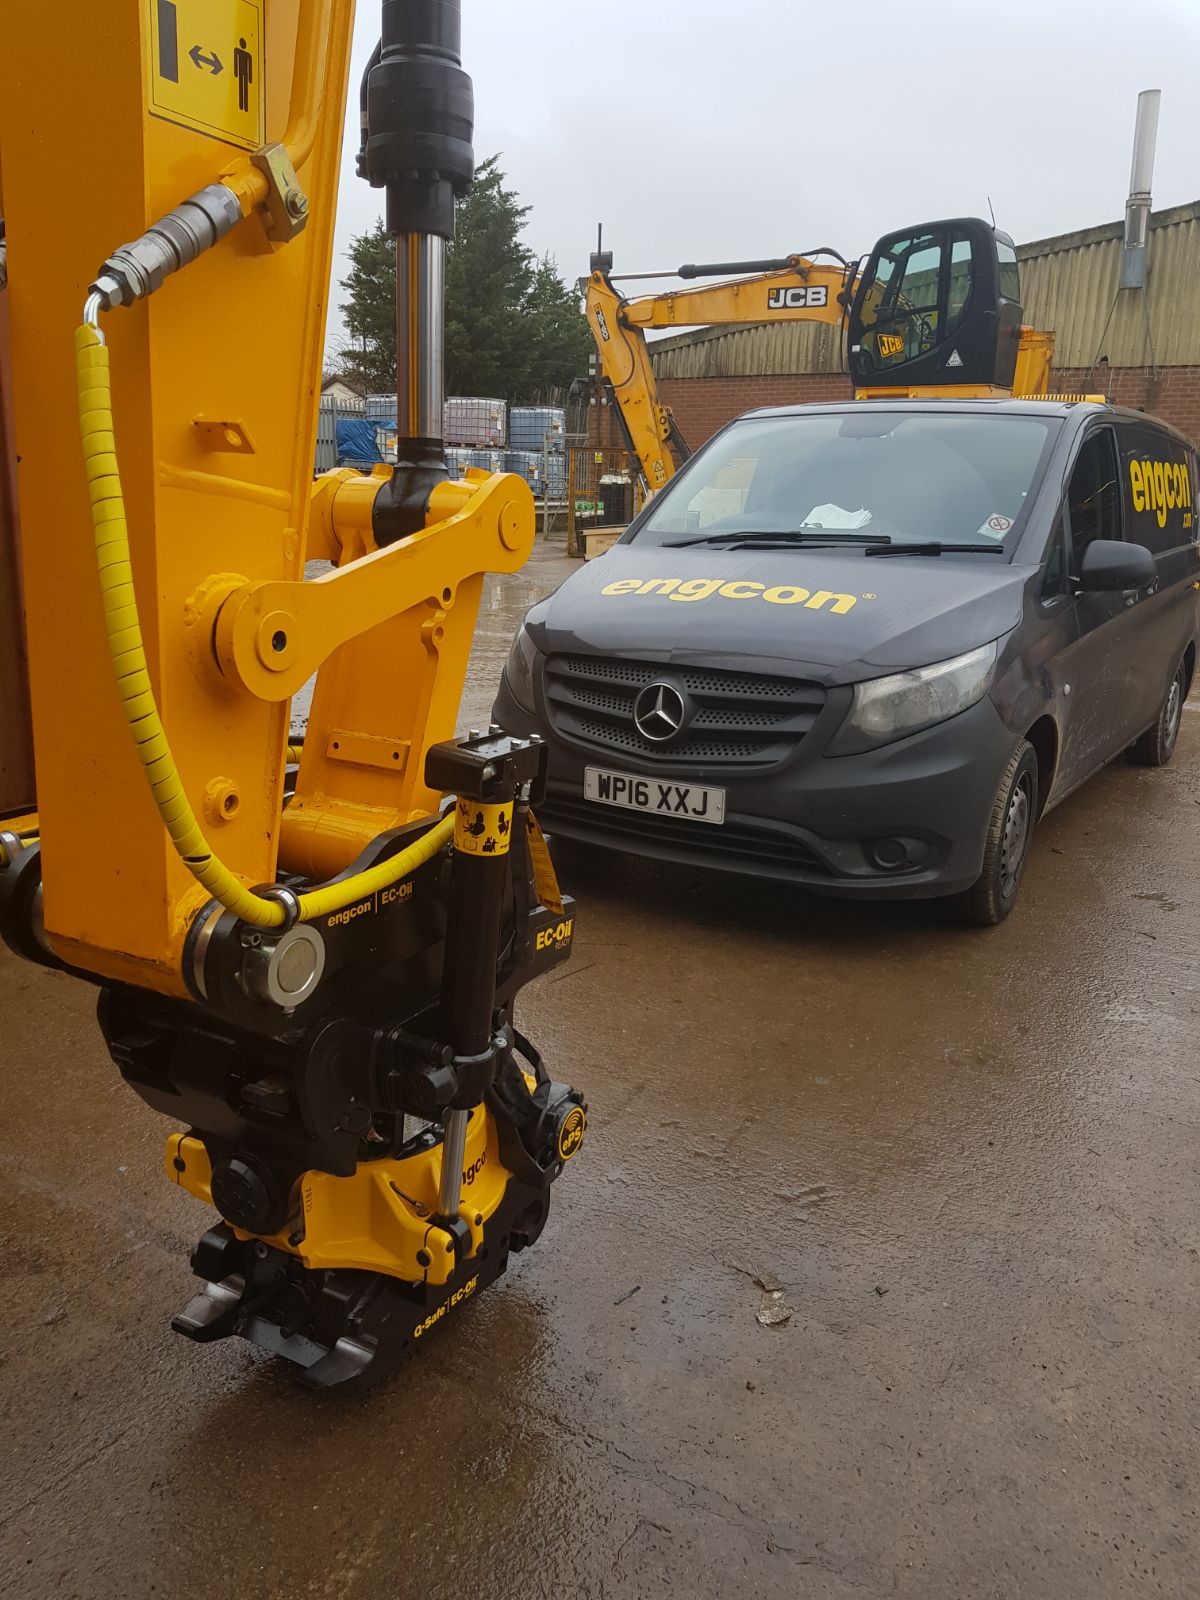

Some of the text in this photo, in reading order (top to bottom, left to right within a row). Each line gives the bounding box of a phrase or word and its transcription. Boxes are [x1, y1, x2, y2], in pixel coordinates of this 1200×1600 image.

[769, 287, 826, 307] JCB
[880, 336, 902, 355] JCB
[1129, 459, 1191, 528] engcon
[598, 773, 708, 816] WP16 XXJ
[327, 882, 413, 927] engcon EC-Oil
[536, 919, 572, 950] EC-Oil
[414, 1276, 477, 1338] Q-Safe EC-Oil
